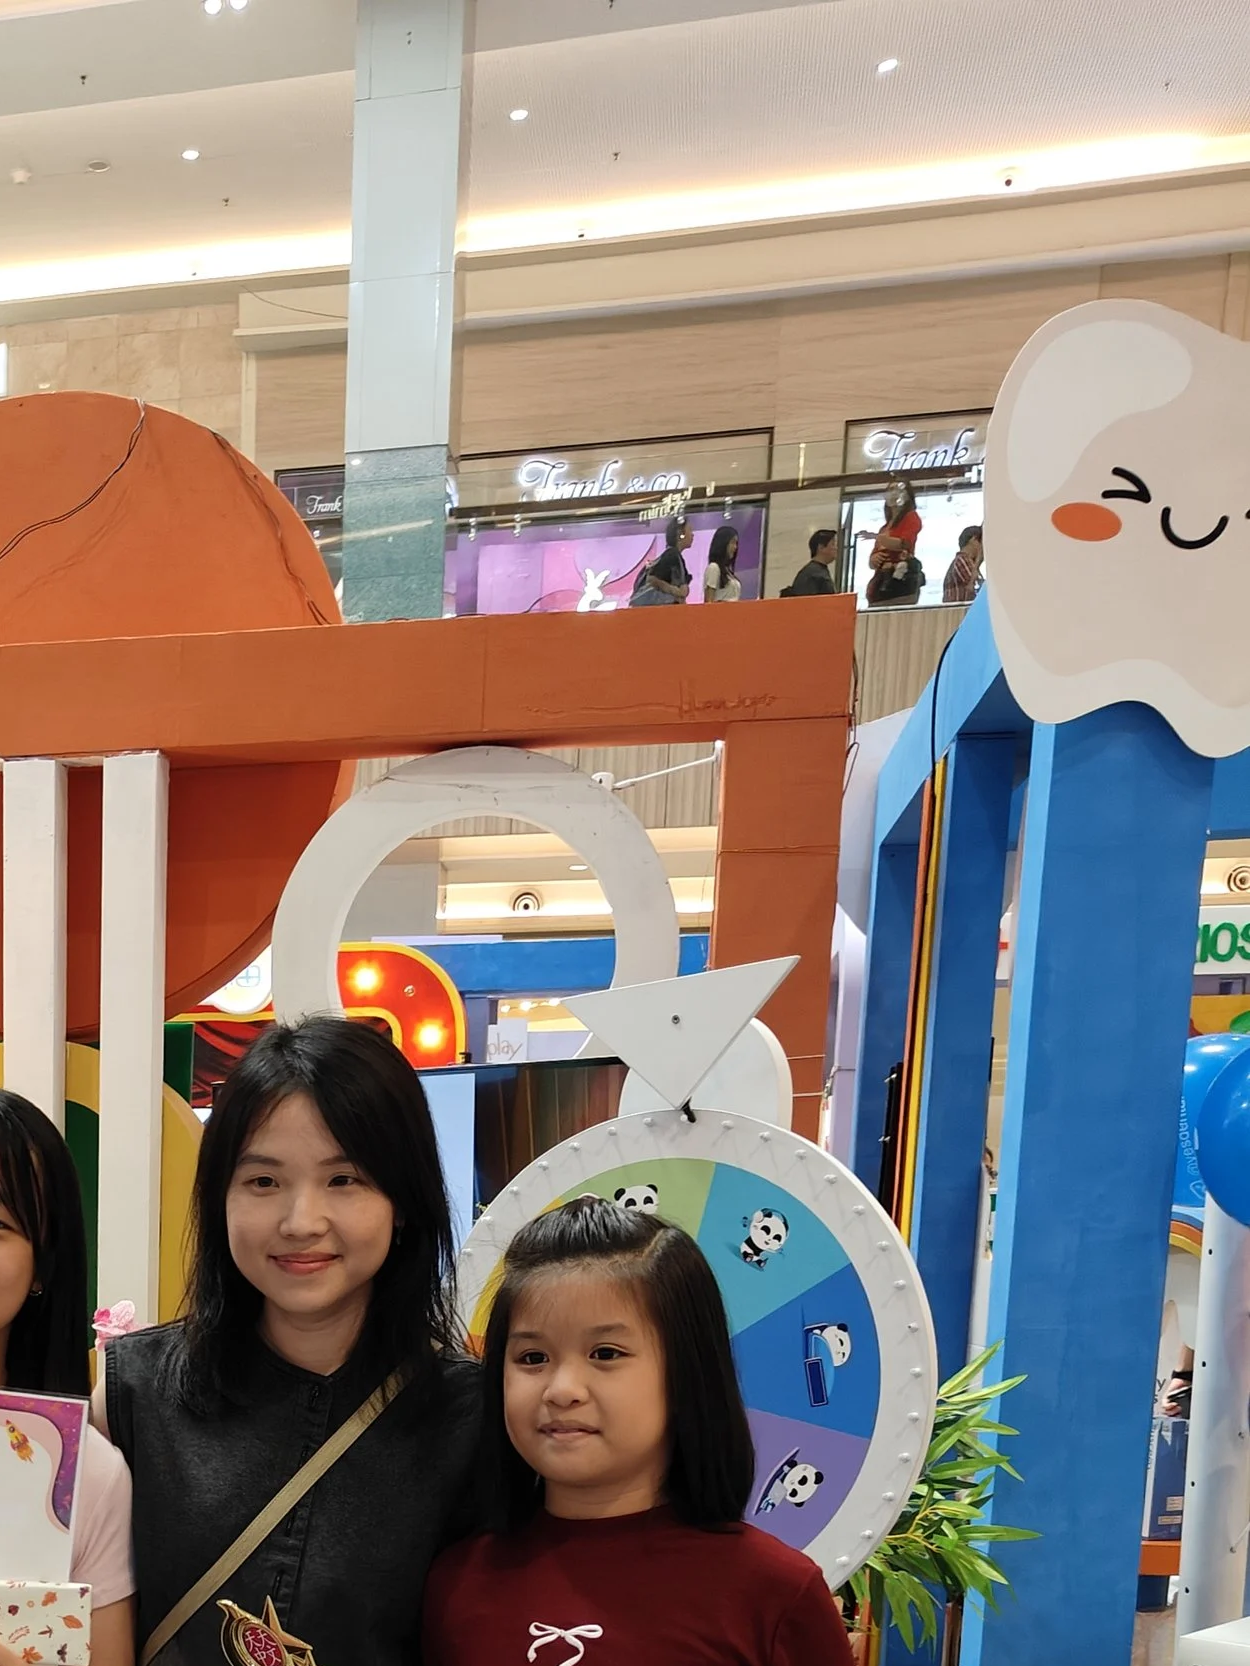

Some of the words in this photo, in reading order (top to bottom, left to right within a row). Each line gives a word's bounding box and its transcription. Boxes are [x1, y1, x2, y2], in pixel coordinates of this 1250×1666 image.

[306, 495, 342, 514] Frank
[1198, 922, 1250, 963] IOS
[245, 1629, 277, 1652] 天天
[254, 1644, 281, 1666] 中文
